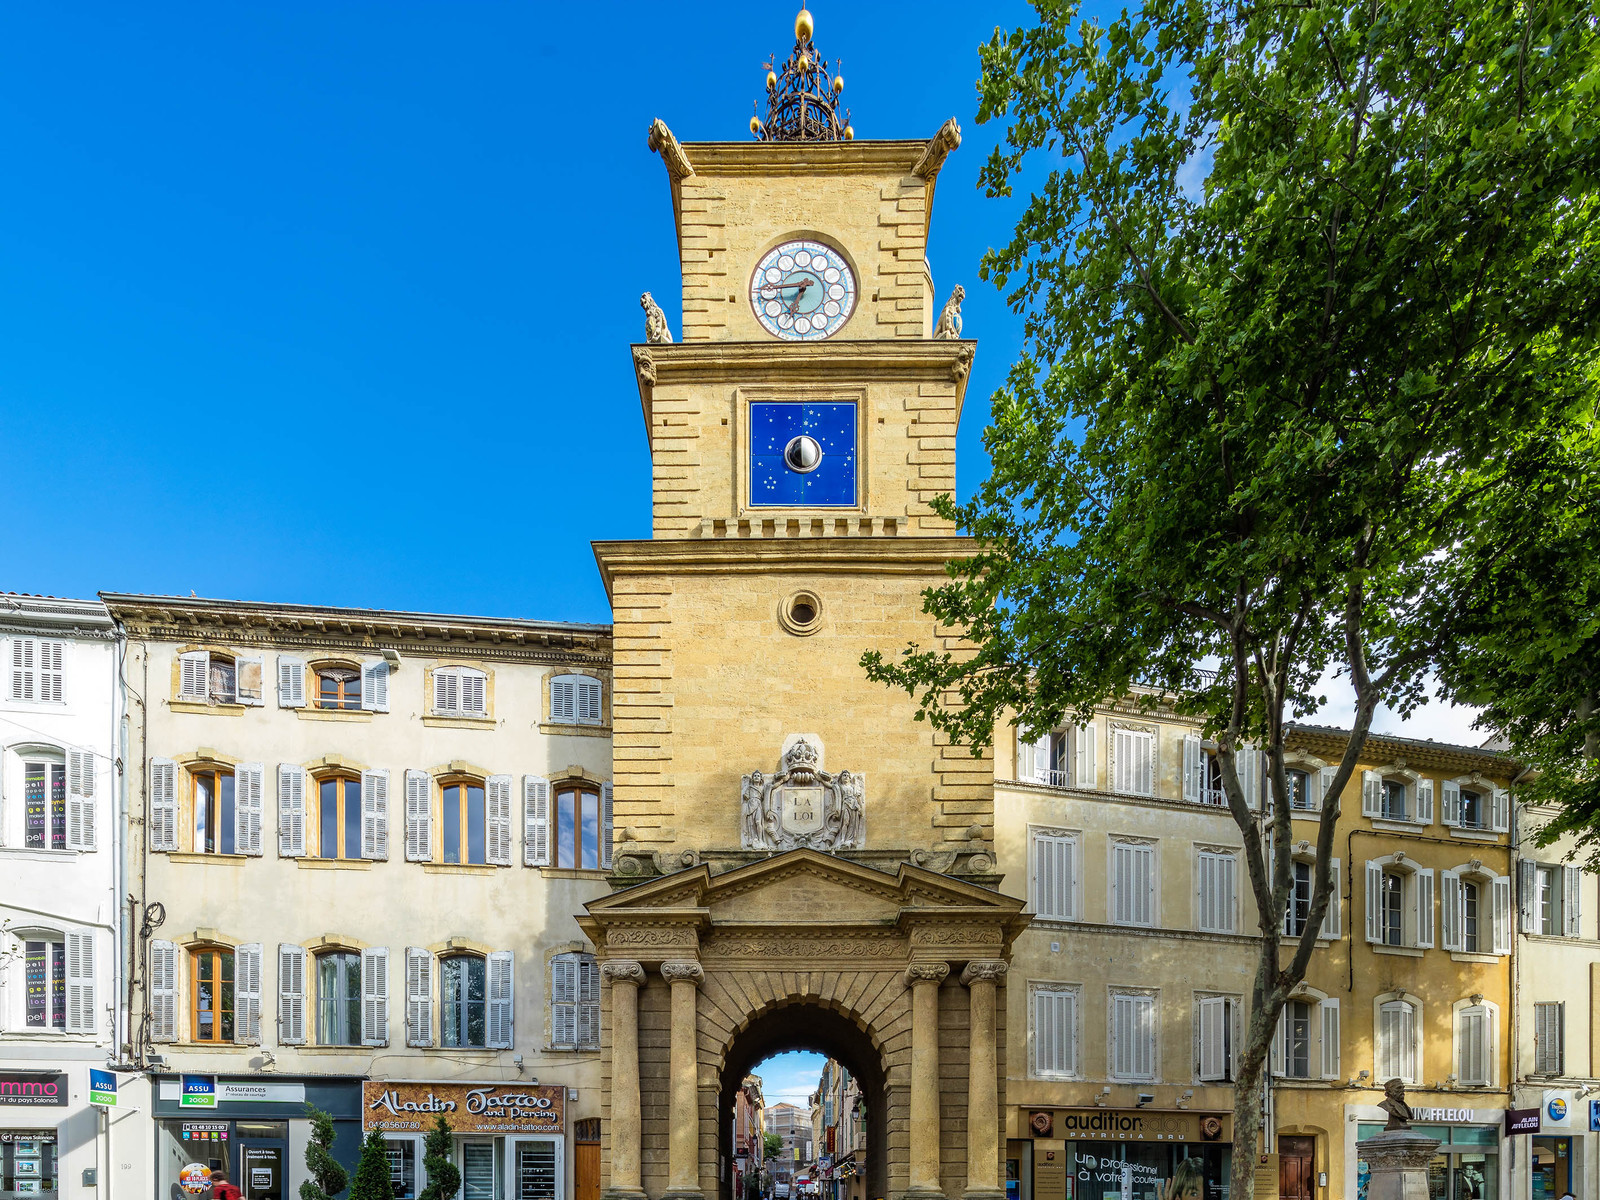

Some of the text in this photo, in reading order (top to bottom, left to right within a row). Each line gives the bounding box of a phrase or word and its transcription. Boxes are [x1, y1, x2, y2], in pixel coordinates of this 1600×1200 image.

[794, 812, 813, 820] LOI
[1, 1082, 58, 1095] mmo
[95, 1082, 113, 1090] ASSU
[95, 1095, 113, 1103] 2000
[370, 1087, 552, 1116] Aladin Tattoo
[484, 1107, 556, 1121] and Piercing
[1511, 1122, 1539, 1130] AFFLELOU
[1070, 1131, 1144, 1139] PATRICIA
[1075, 1152, 1097, 1165] un
[1078, 1168, 1091, 1181] à
[1095, 1171, 1122, 1183] votre
